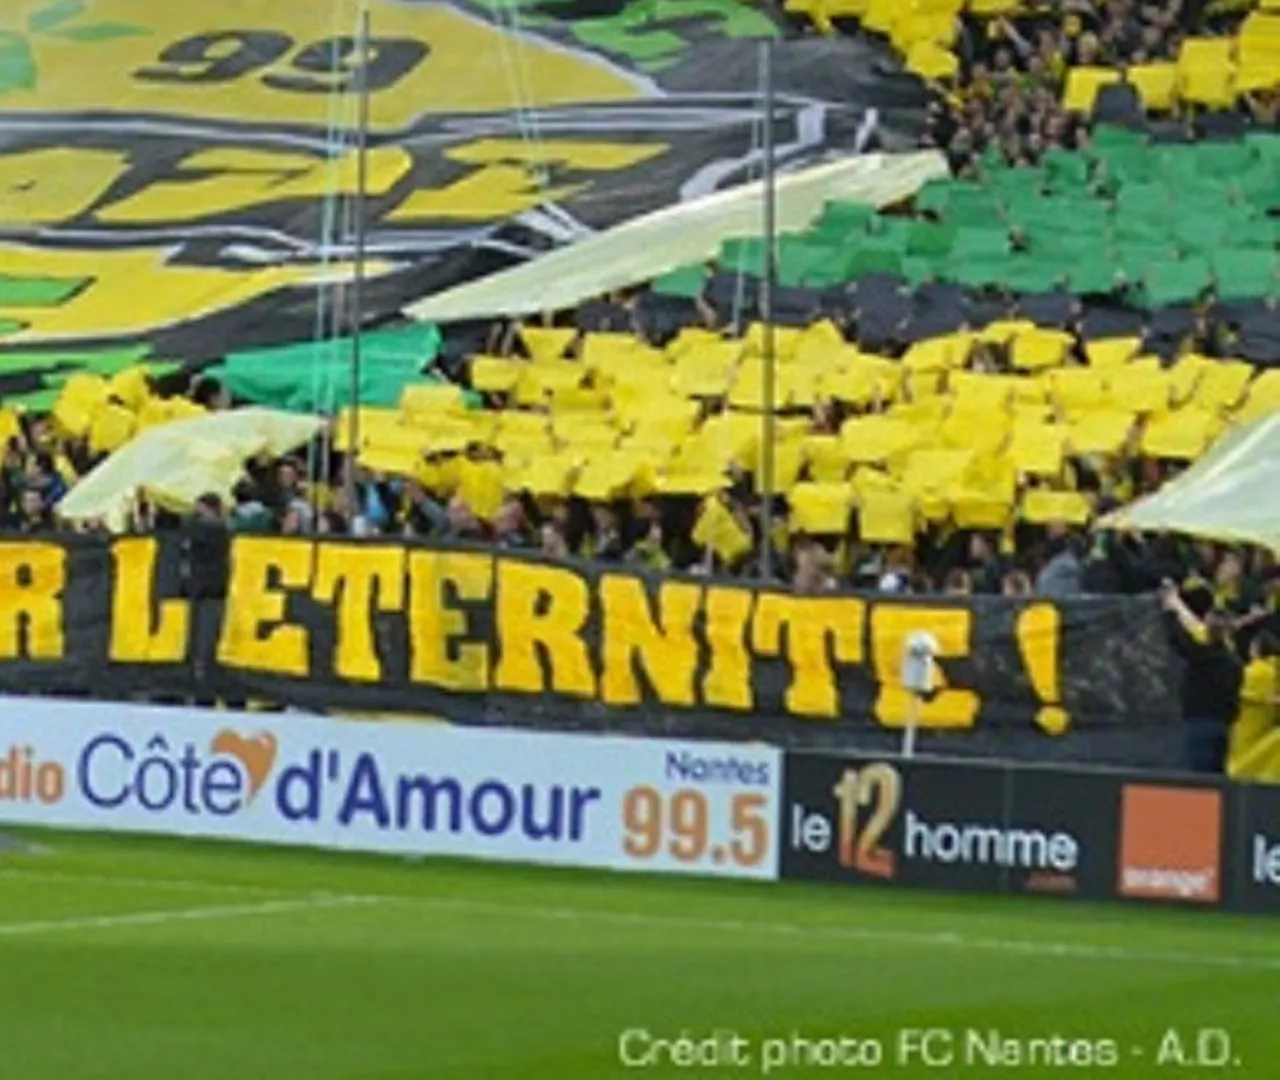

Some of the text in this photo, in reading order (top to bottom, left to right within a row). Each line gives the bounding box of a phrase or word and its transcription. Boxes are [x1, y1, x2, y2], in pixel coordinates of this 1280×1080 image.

[77, 733, 246, 816] Côte
[276, 747, 602, 841] d'Amour
[666, 750, 772, 787] Nantes
[621, 786, 769, 867] 99.5
[792, 763, 1079, 880] le 12 homme
